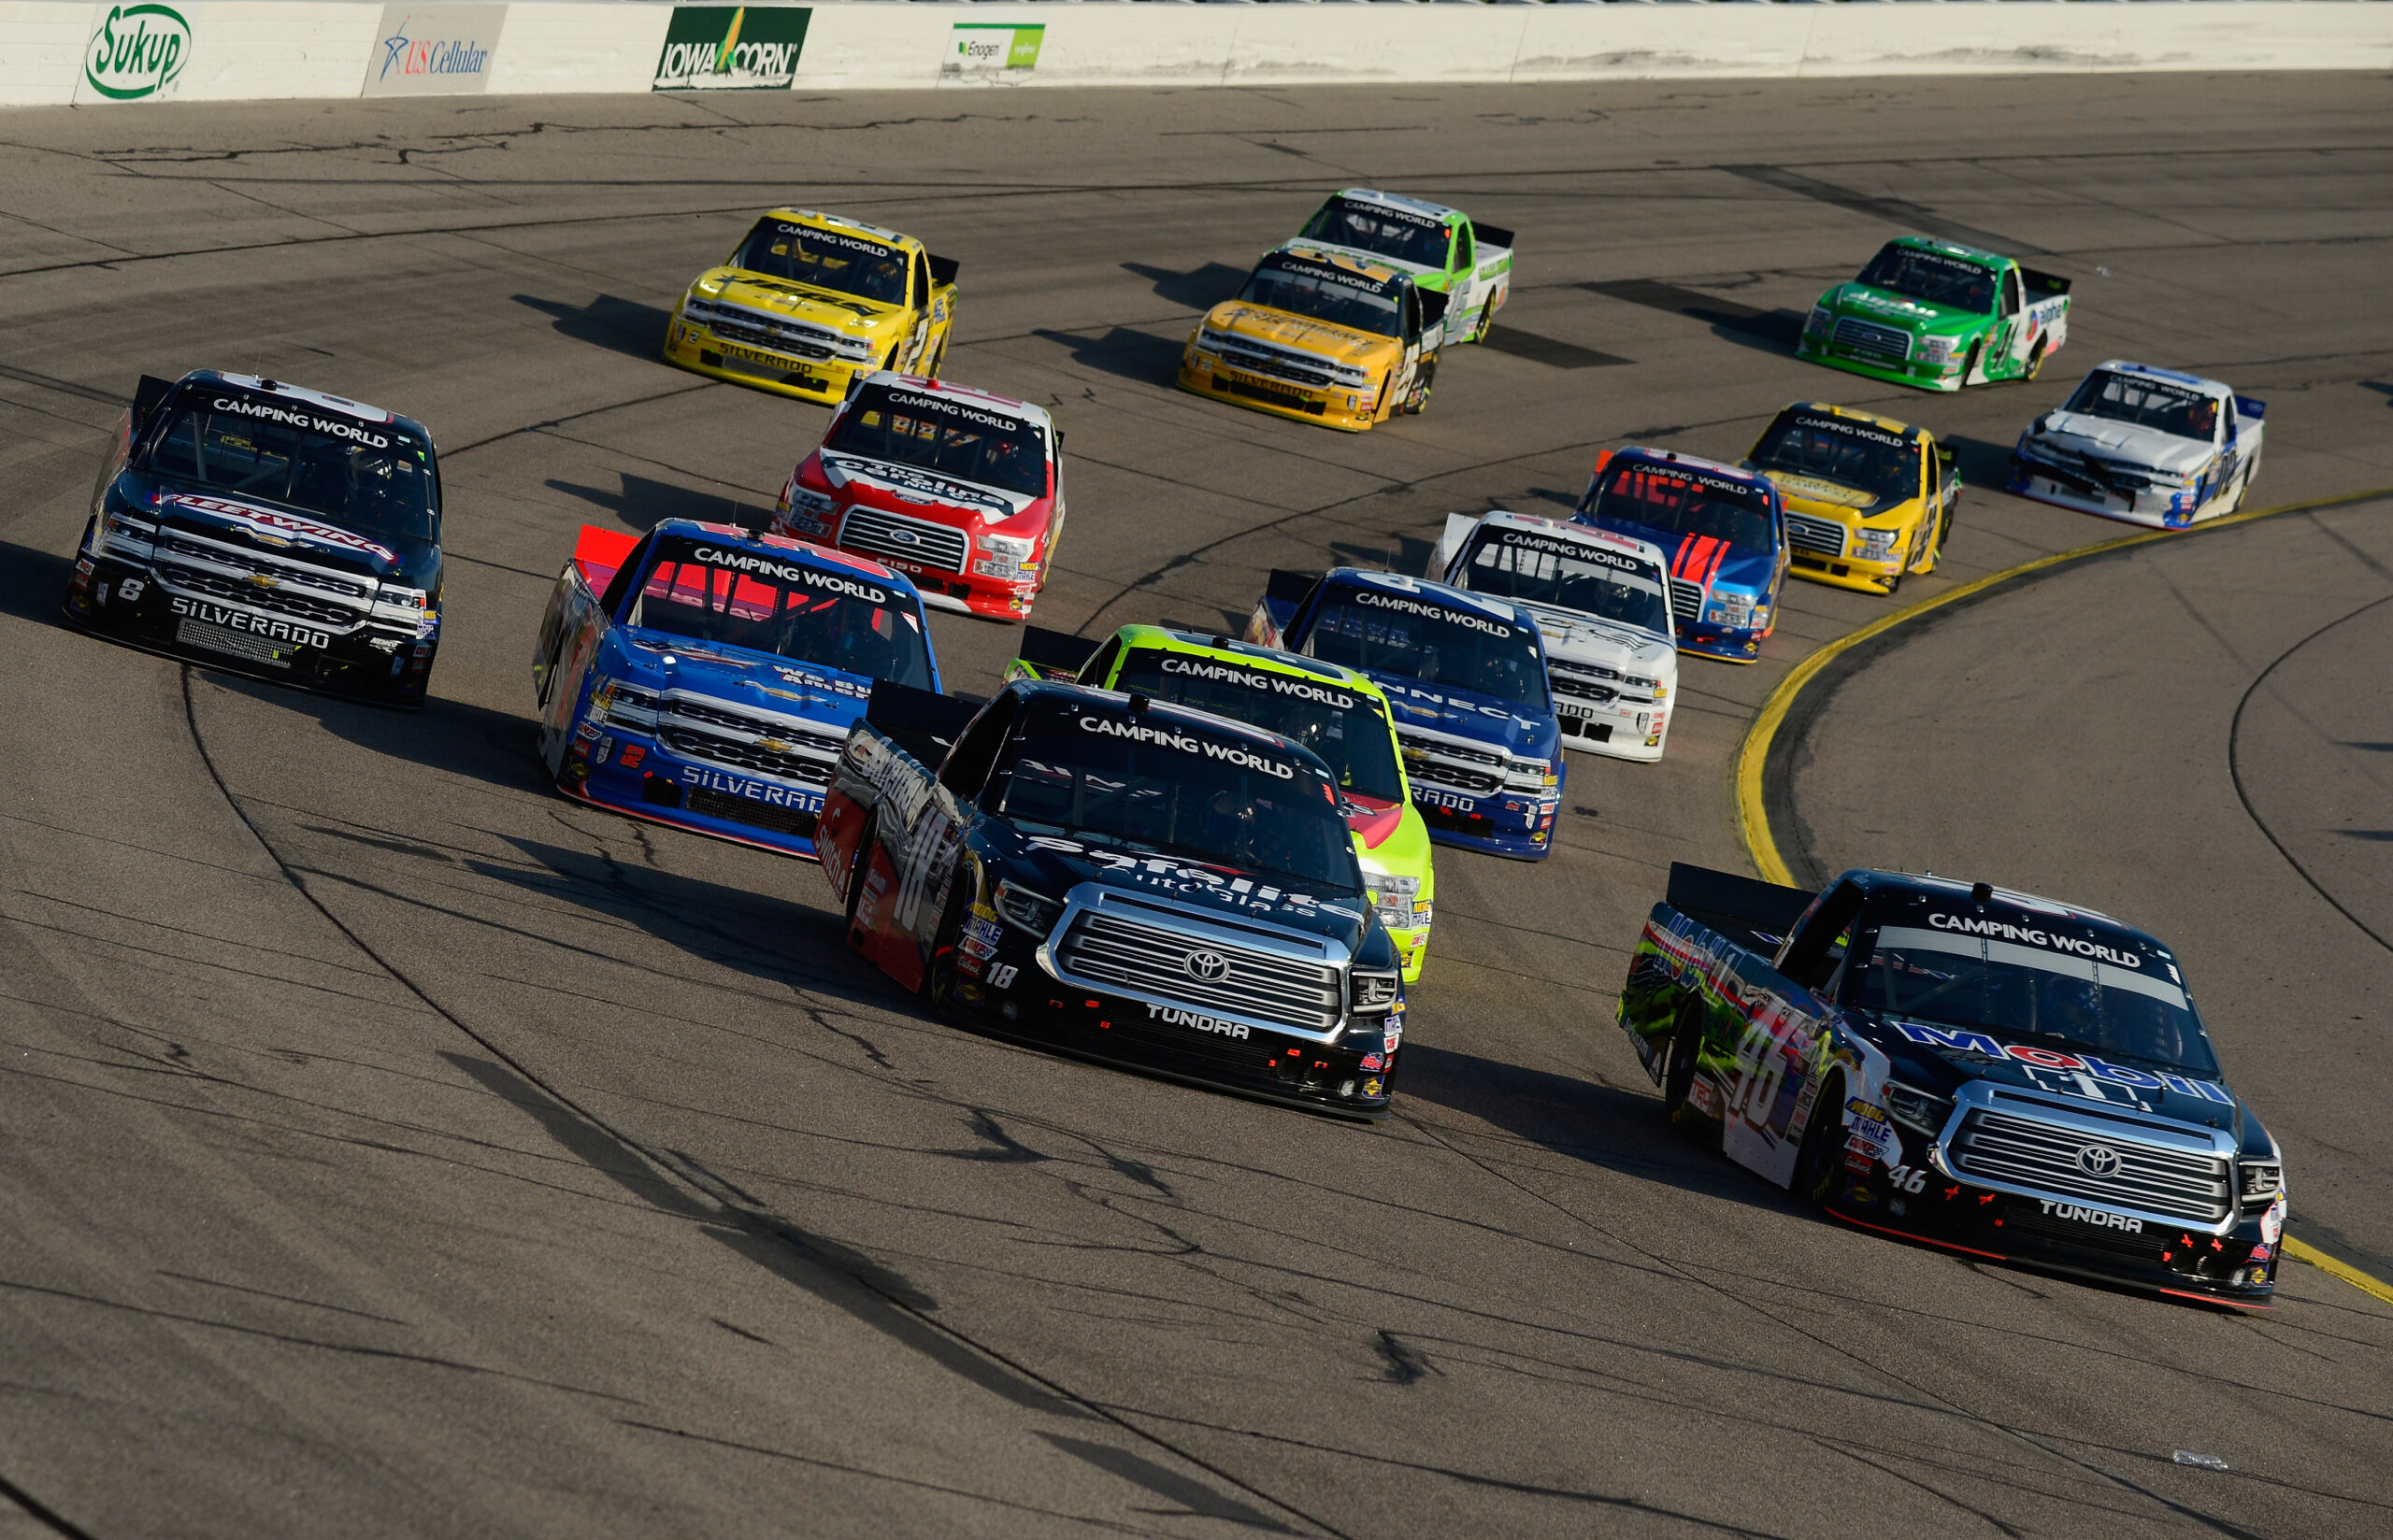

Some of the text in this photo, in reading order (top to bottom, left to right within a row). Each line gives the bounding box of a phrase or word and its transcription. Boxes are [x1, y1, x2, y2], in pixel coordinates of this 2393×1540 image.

[96, 6, 181, 90] Sukup
[430, 40, 487, 74] Cellular
[661, 43, 795, 78] IOWA CORN
[968, 41, 999, 60] Enogen
[1344, 200, 1437, 229] CAMPING WORLD
[777, 223, 888, 258] CAMPING WORLD
[1282, 262, 1383, 294] CAMPING WORLD
[1896, 248, 1983, 275] CAMPING WORLD
[719, 342, 813, 374] SILVERADO
[2109, 374, 2200, 401] CAMPING WORLD
[213, 397, 389, 449] CAMPING WORLD
[888, 392, 959, 415] CAMPING
[961, 408, 1017, 432] WORLD
[1796, 416, 1903, 449] CAMPING WORLD
[835, 459, 1006, 505] Carolina
[1632, 463, 1747, 496] CAMPING WORLD
[155, 492, 394, 562] FLEETWING
[1502, 532, 1638, 572] CAMPING WORLD
[119, 578, 145, 601] 8
[694, 547, 886, 604] CAMPING WORLD
[170, 597, 330, 650] SILVERADO
[1354, 592, 1511, 639] CAMPING WORLD
[1161, 658, 1354, 710] CAMPING WORLD
[1360, 673, 1541, 730] NNECT
[621, 744, 647, 768] 52
[1079, 716, 1294, 780] CAMPING WORLD
[681, 765, 824, 814] SILVERAD
[893, 805, 950, 933] 18
[1026, 835, 1364, 923] Safelite
[966, 916, 1003, 946] MAHLE
[1927, 912, 2142, 968] CAMPING WORLD
[985, 962, 1019, 990] 18
[1145, 1003, 1250, 1040] TUNDRA
[1889, 1020, 2237, 1108] Mobil
[1847, 1100, 1885, 1123] MOOG
[1851, 1116, 1892, 1143] MAHLE
[1888, 1164, 1928, 1195] 46
[2039, 1198, 2143, 1234] TUNDRA
